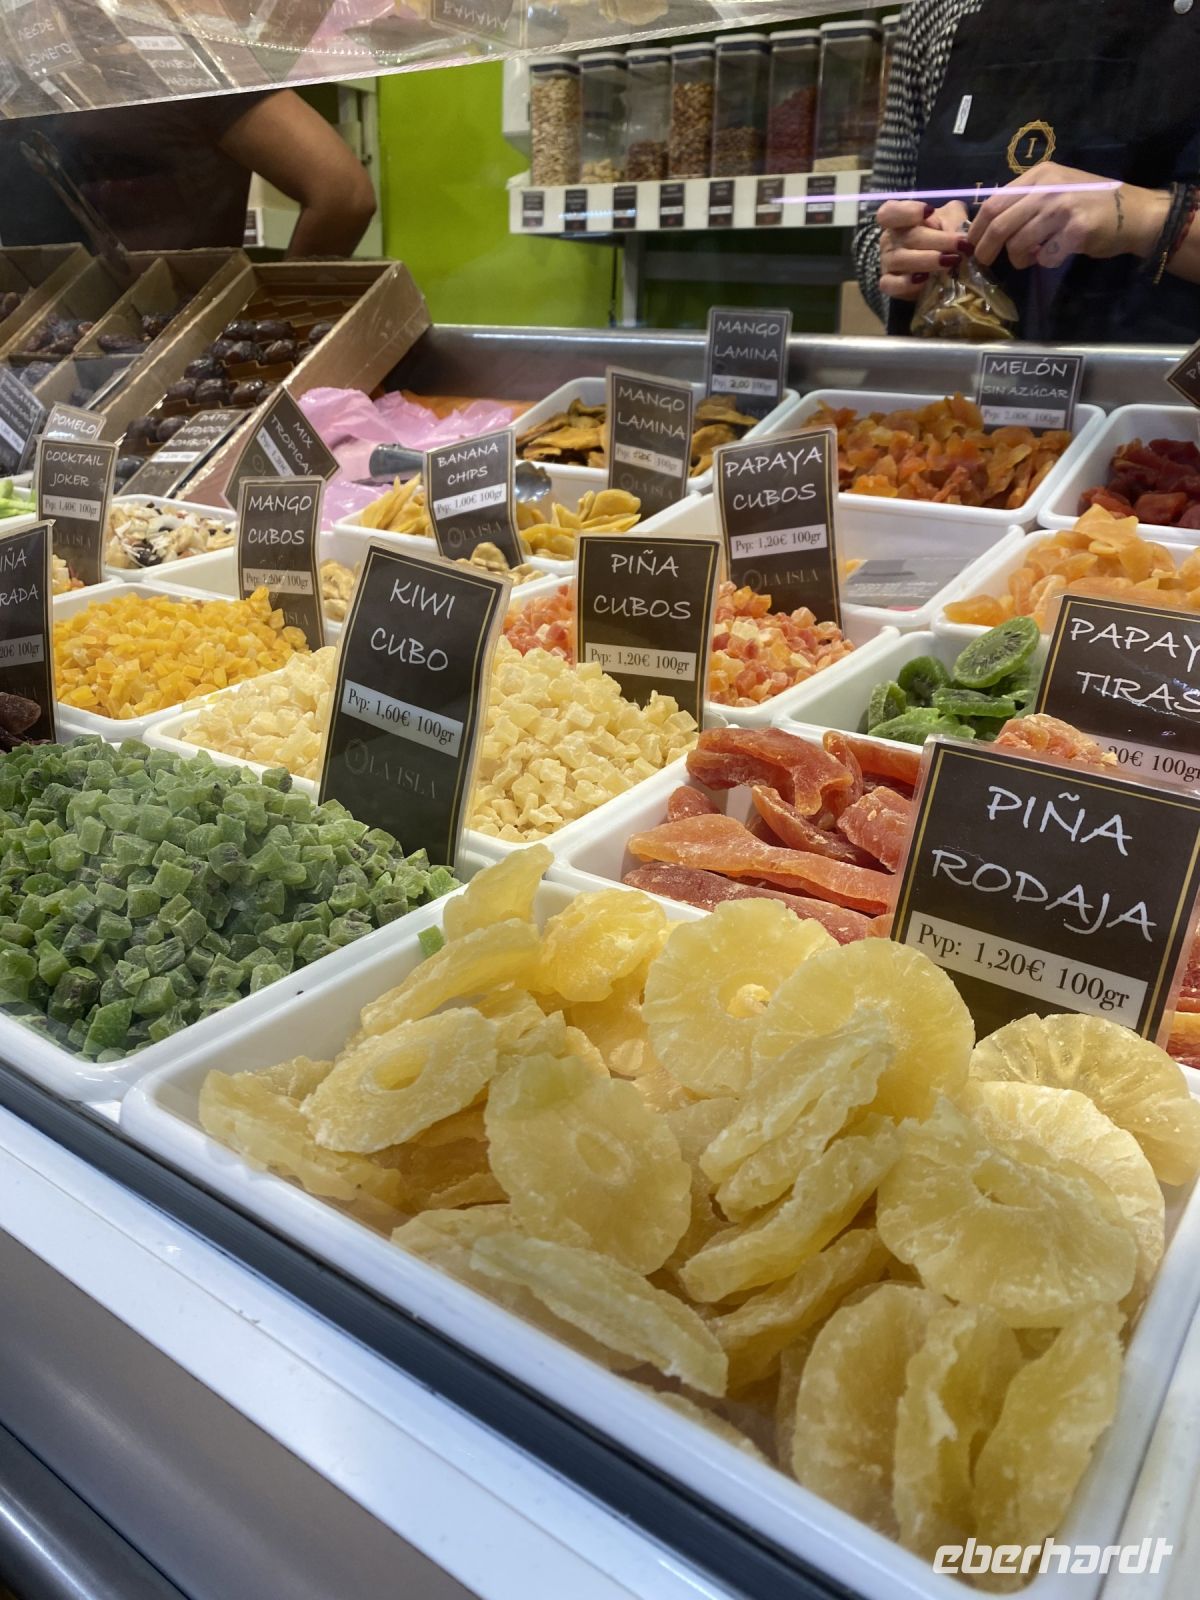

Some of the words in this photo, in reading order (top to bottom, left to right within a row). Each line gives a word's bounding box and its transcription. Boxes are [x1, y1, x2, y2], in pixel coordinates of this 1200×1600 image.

[716, 320, 781, 338] MANGO
[714, 345, 779, 362] LAMINA
[989, 357, 1068, 377] MELÓN
[617, 385, 686, 413] MANGO
[982, 385, 1006, 395] SIN
[1008, 385, 1069, 399] AZÚCAR
[51, 412, 97, 435] POMELO
[292, 421, 313, 449] MIX
[617, 411, 687, 441] LAMINA
[45, 449, 105, 467] COCKTAIL
[436, 441, 499, 468] BANANA
[724, 446, 823, 479] PAPAYA
[49, 472, 91, 487] JOKER
[446, 465, 489, 486] CHIPS
[248, 493, 313, 516] MANGO
[732, 482, 817, 511] CUBOS
[247, 526, 306, 546] CUBOS
[792, 530, 822, 545] 100gr
[0, 546, 28, 574] IÑA
[610, 549, 680, 578] PIÑA
[0, 582, 39, 607] RADA
[389, 578, 456, 619] KIWI
[593, 594, 692, 620] CUBOS
[370, 627, 449, 672] CUBO
[1070, 617, 1200, 673] PAPAY
[655, 655, 690, 675] 100gr
[1076, 670, 1200, 713] TIRAS
[348, 687, 372, 714] Pvp:
[375, 700, 412, 727] 1,60€
[416, 715, 456, 746] 100gr
[986, 785, 1133, 856] PIÑA
[931, 849, 1157, 942] RODAJA
[916, 922, 963, 959] Pvp:
[973, 941, 1047, 983] 1,20€
[1055, 966, 1131, 1012] 100gr
